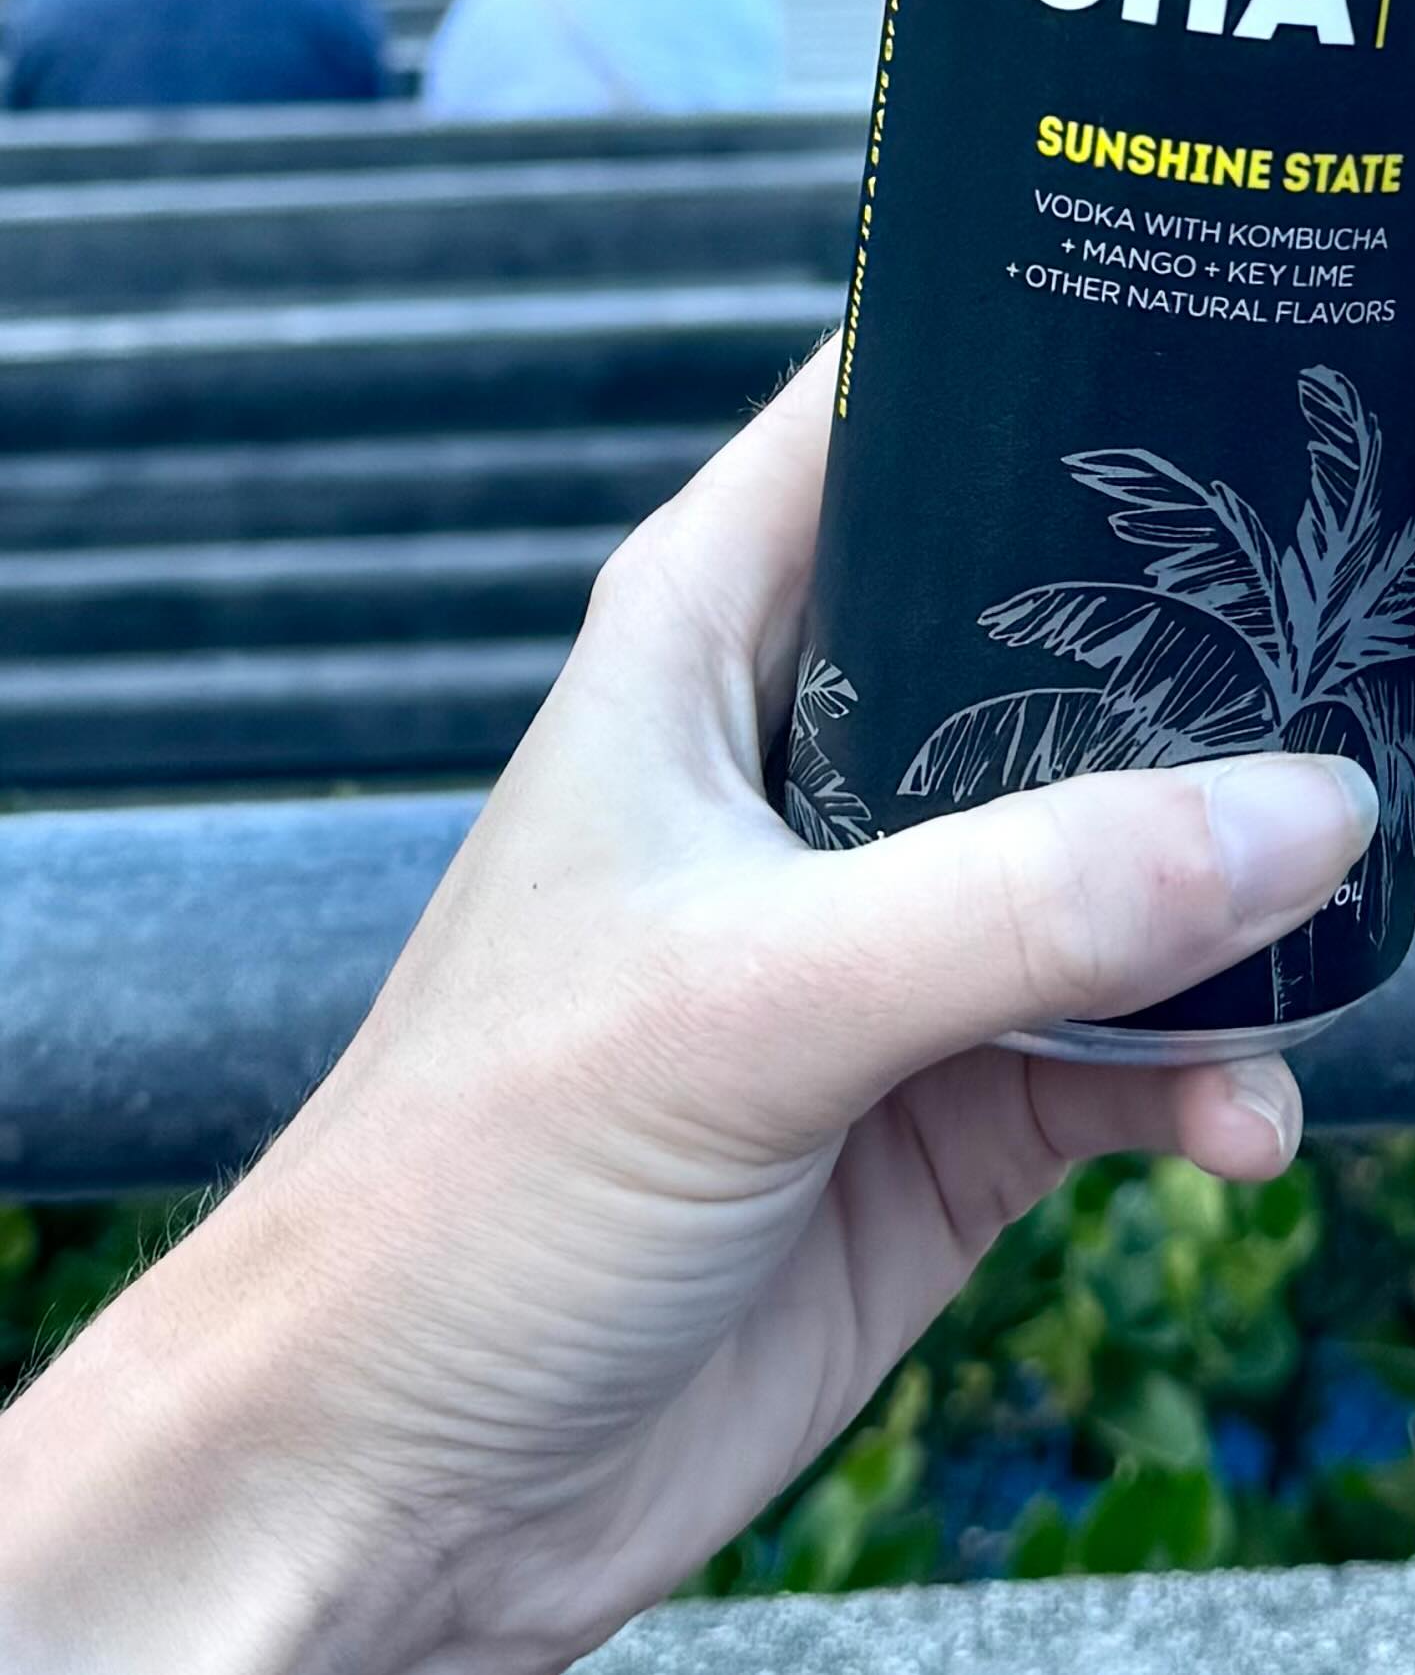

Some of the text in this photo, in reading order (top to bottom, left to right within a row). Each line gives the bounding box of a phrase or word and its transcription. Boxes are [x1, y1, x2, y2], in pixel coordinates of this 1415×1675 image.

[1035, 114, 1405, 195] SUNSHINE STATE
[1033, 188, 1389, 252] VODKA WITH KOMBUCHA
[1024, 263, 1122, 306] OTHER
[1126, 284, 1268, 324] NATURAL
[1274, 298, 1397, 325] FLAVORS
[1081, 238, 1198, 279] MANGO
[1226, 260, 1288, 287] KEY
[1291, 263, 1356, 288] LIME
